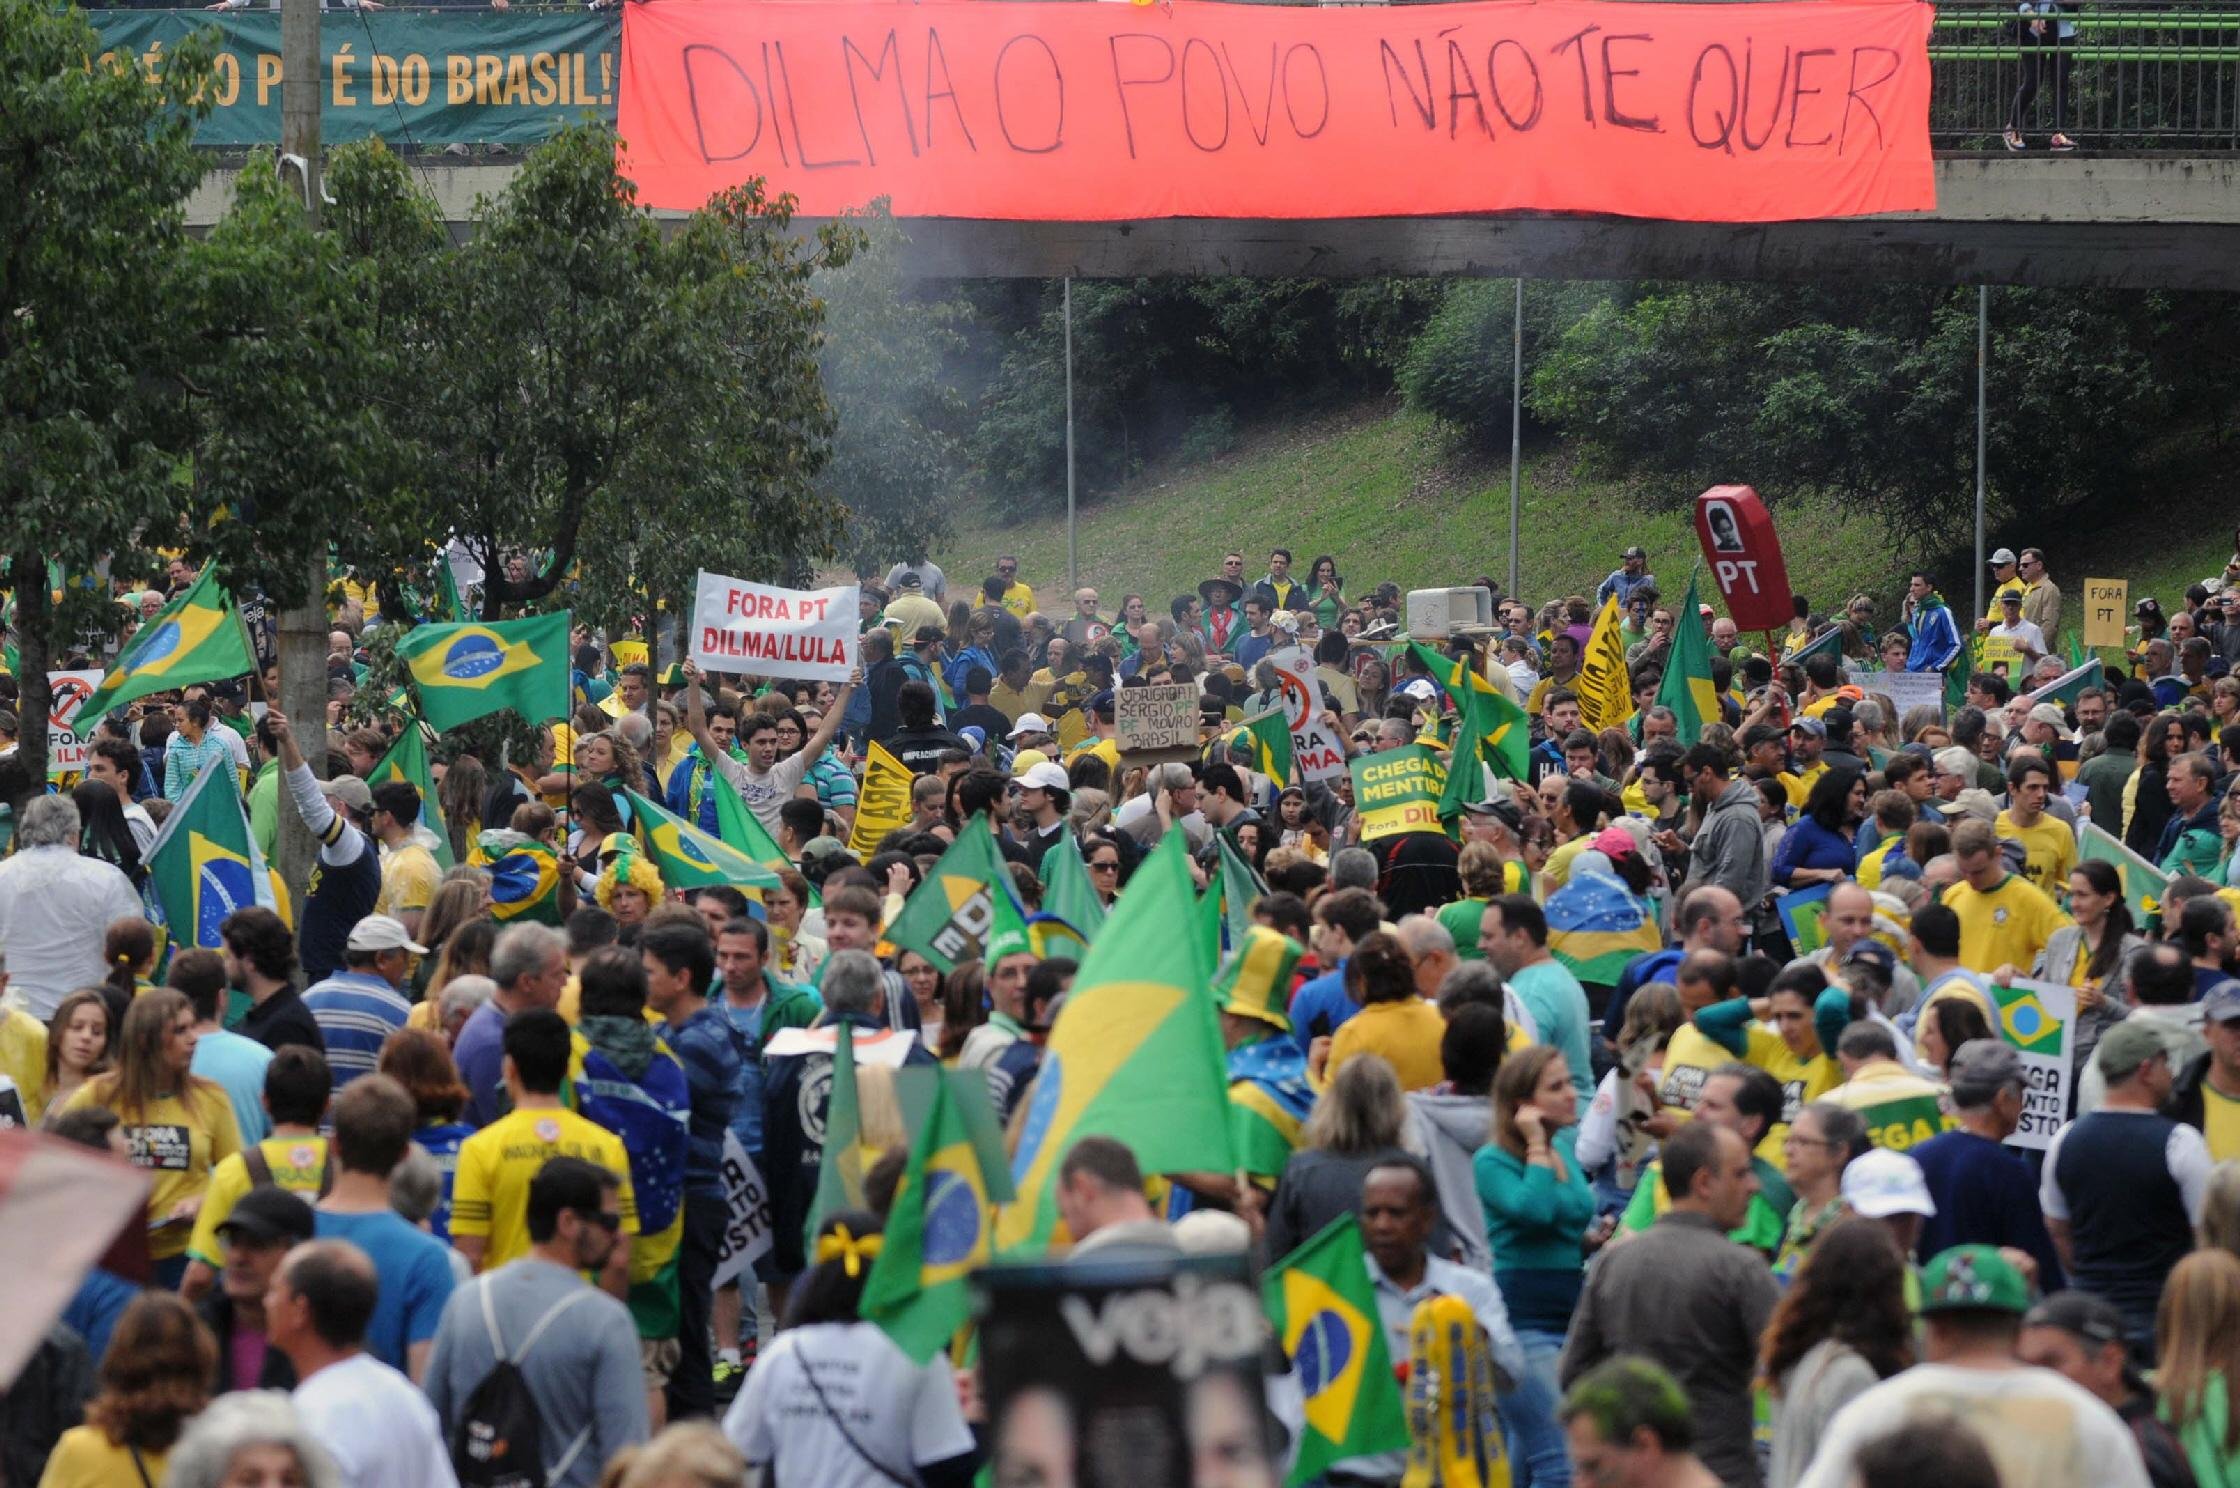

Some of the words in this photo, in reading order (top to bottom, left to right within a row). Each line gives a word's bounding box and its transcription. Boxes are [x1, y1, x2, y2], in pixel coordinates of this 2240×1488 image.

[332, 44, 356, 106] É
[371, 54, 430, 106] DO
[447, 52, 612, 106] BRASIL!
[683, 26, 978, 169] DILMA
[995, 33, 1065, 154] O
[1108, 33, 1331, 161] POVO
[1378, 23, 1545, 143] NÃO
[1550, 22, 1668, 135] TE
[1687, 35, 1902, 158] QUER
[1716, 560, 1760, 594] PT
[727, 588, 791, 621] FORA
[799, 597, 829, 621] PT
[2090, 587, 2122, 600] FORA
[2097, 608, 2114, 622] PT
[702, 626, 847, 666] DILMA/LULA
[1119, 702, 1173, 718] SERGIO
[1127, 730, 1185, 747] BRASIL
[1362, 757, 1434, 783] CHEGA
[1367, 820, 1399, 833] Fora
